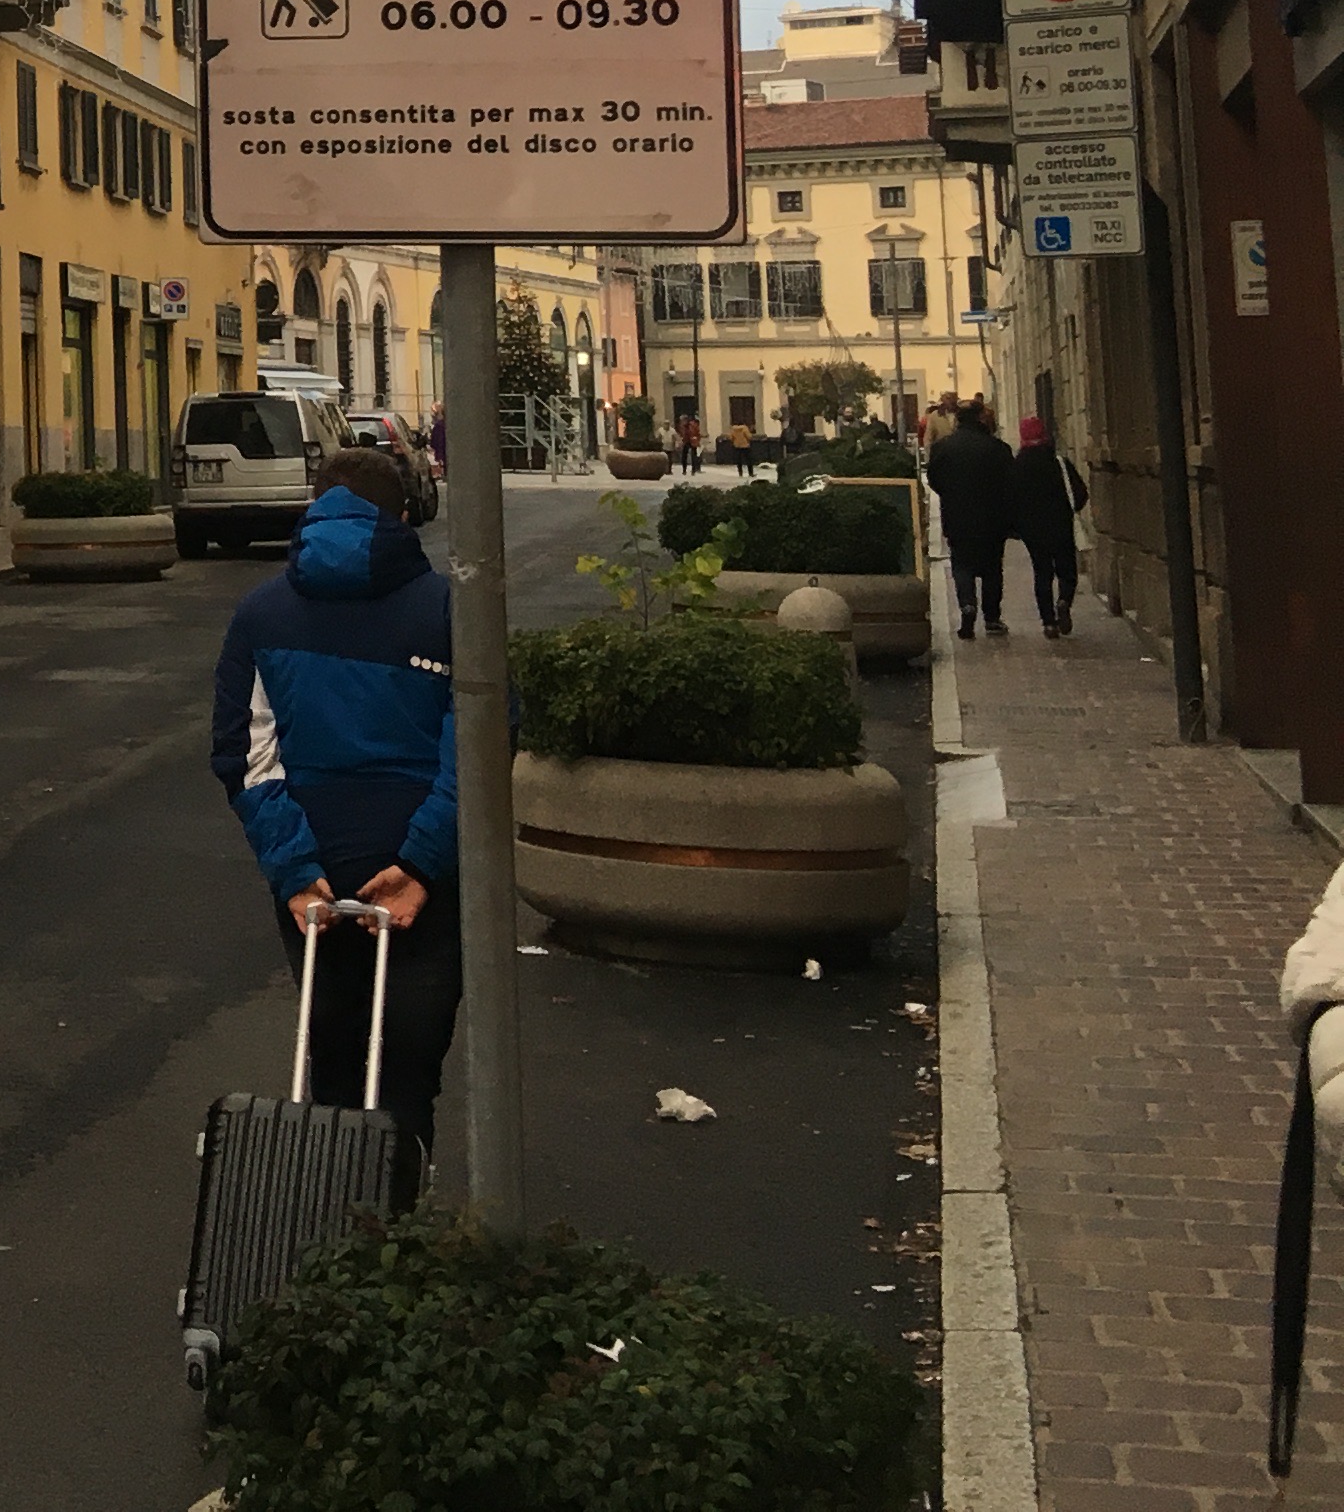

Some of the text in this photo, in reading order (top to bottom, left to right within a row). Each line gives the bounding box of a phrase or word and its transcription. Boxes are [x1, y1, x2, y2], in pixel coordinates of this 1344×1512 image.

[380, 0, 508, 31] 06.00
[1037, 25, 1098, 39] carico e
[1018, 37, 1120, 56] scarico merci
[223, 101, 713, 128] sosta consentita per max 30 min.
[240, 133, 694, 158] con esposizione del disco orario
[1045, 143, 1105, 155] accesso
[1035, 155, 1116, 170] controllato
[1023, 171, 1131, 185] da telecamere
[1094, 221, 1120, 230] TAXI
[1094, 233, 1122, 243] NCC
